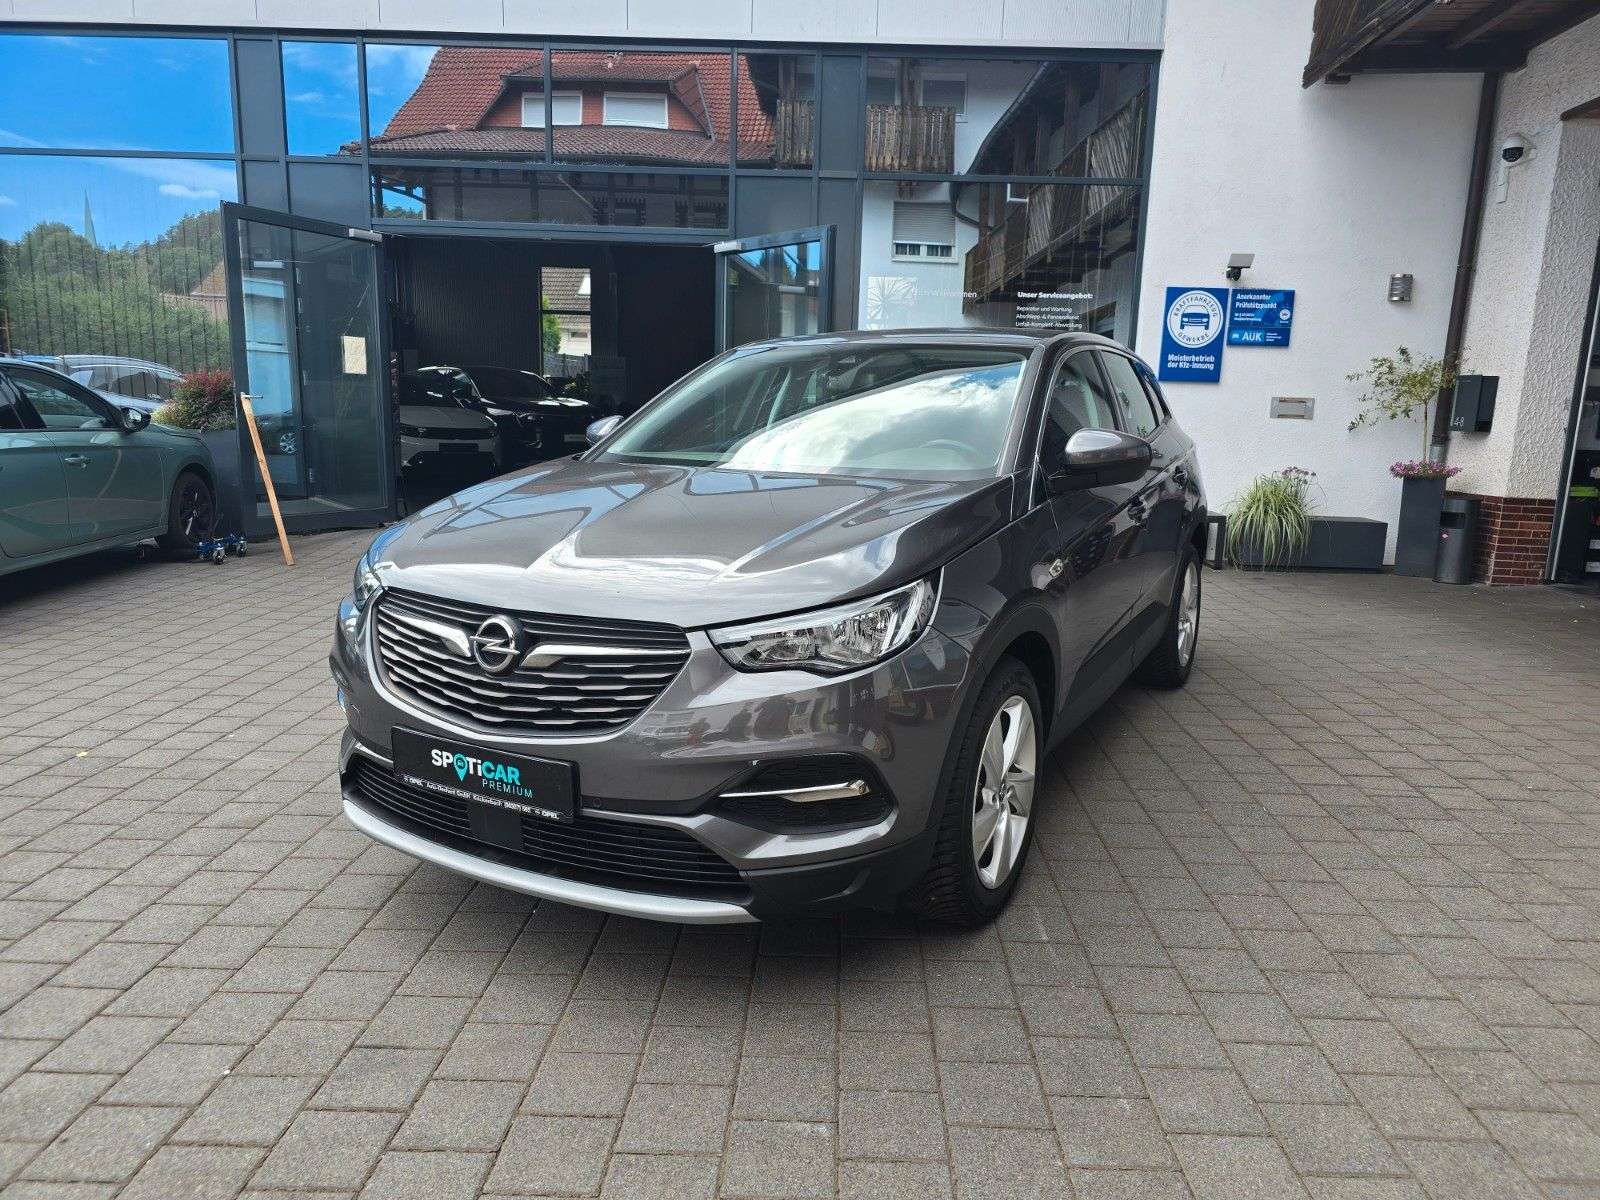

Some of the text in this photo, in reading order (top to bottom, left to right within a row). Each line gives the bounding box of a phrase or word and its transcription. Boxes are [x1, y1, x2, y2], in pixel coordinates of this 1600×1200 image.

[1017, 291, 1093, 300] Unser Serviceangebot:
[1167, 353, 1215, 362] Meisterbetrieb
[482, 778, 533, 798] PREMIUM
